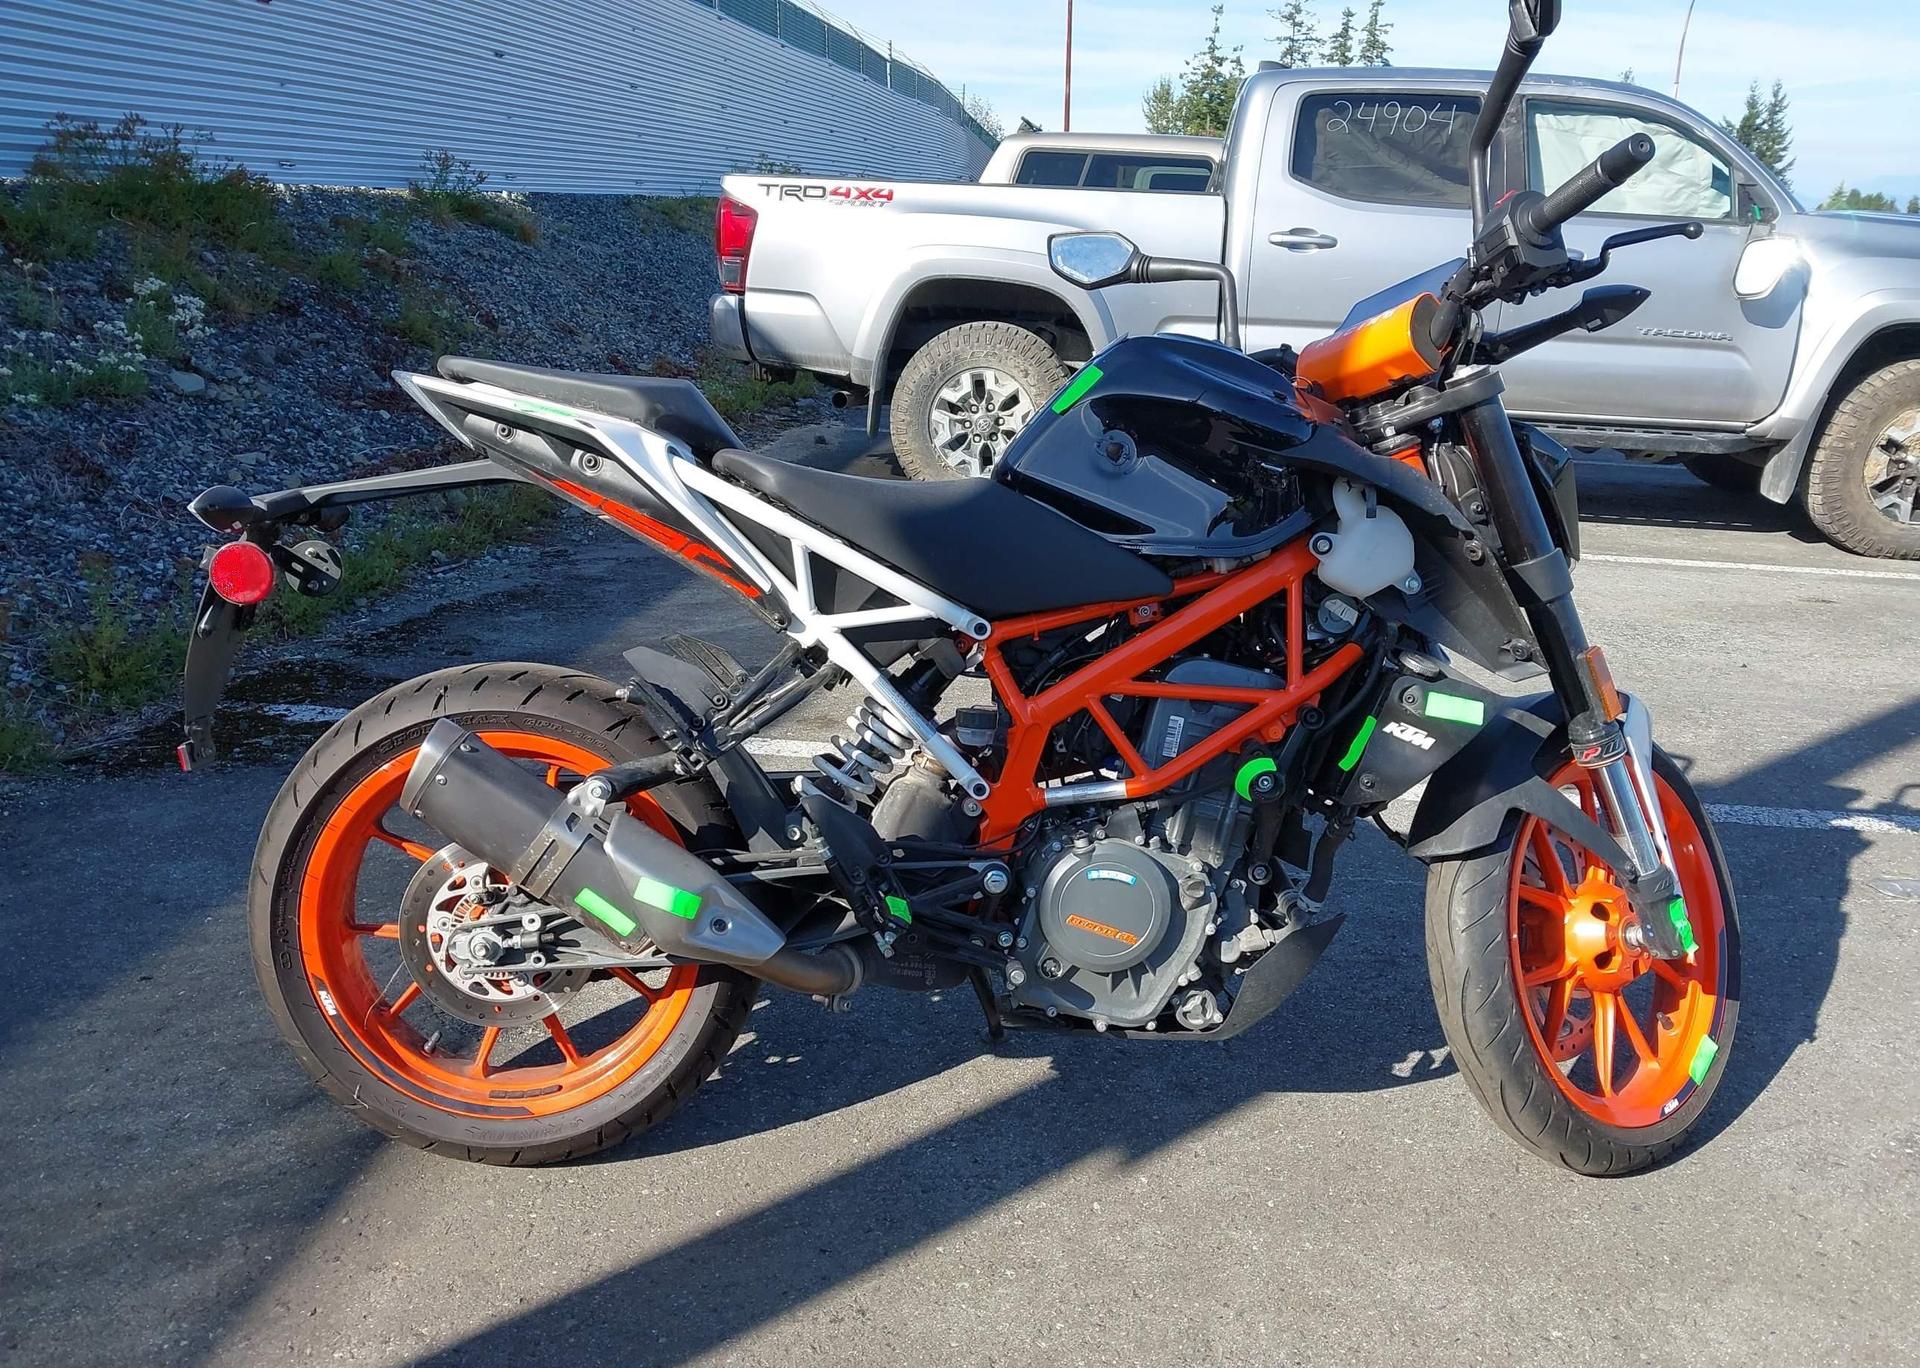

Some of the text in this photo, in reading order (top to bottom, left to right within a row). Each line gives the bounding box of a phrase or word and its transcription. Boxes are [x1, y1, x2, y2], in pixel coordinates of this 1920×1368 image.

[1326, 100, 1457, 135] 24904
[758, 183, 827, 202] TRD
[1636, 325, 1734, 342] TACOMA
[1382, 721, 1437, 751] KTM
[317, 990, 338, 1017] KTM
